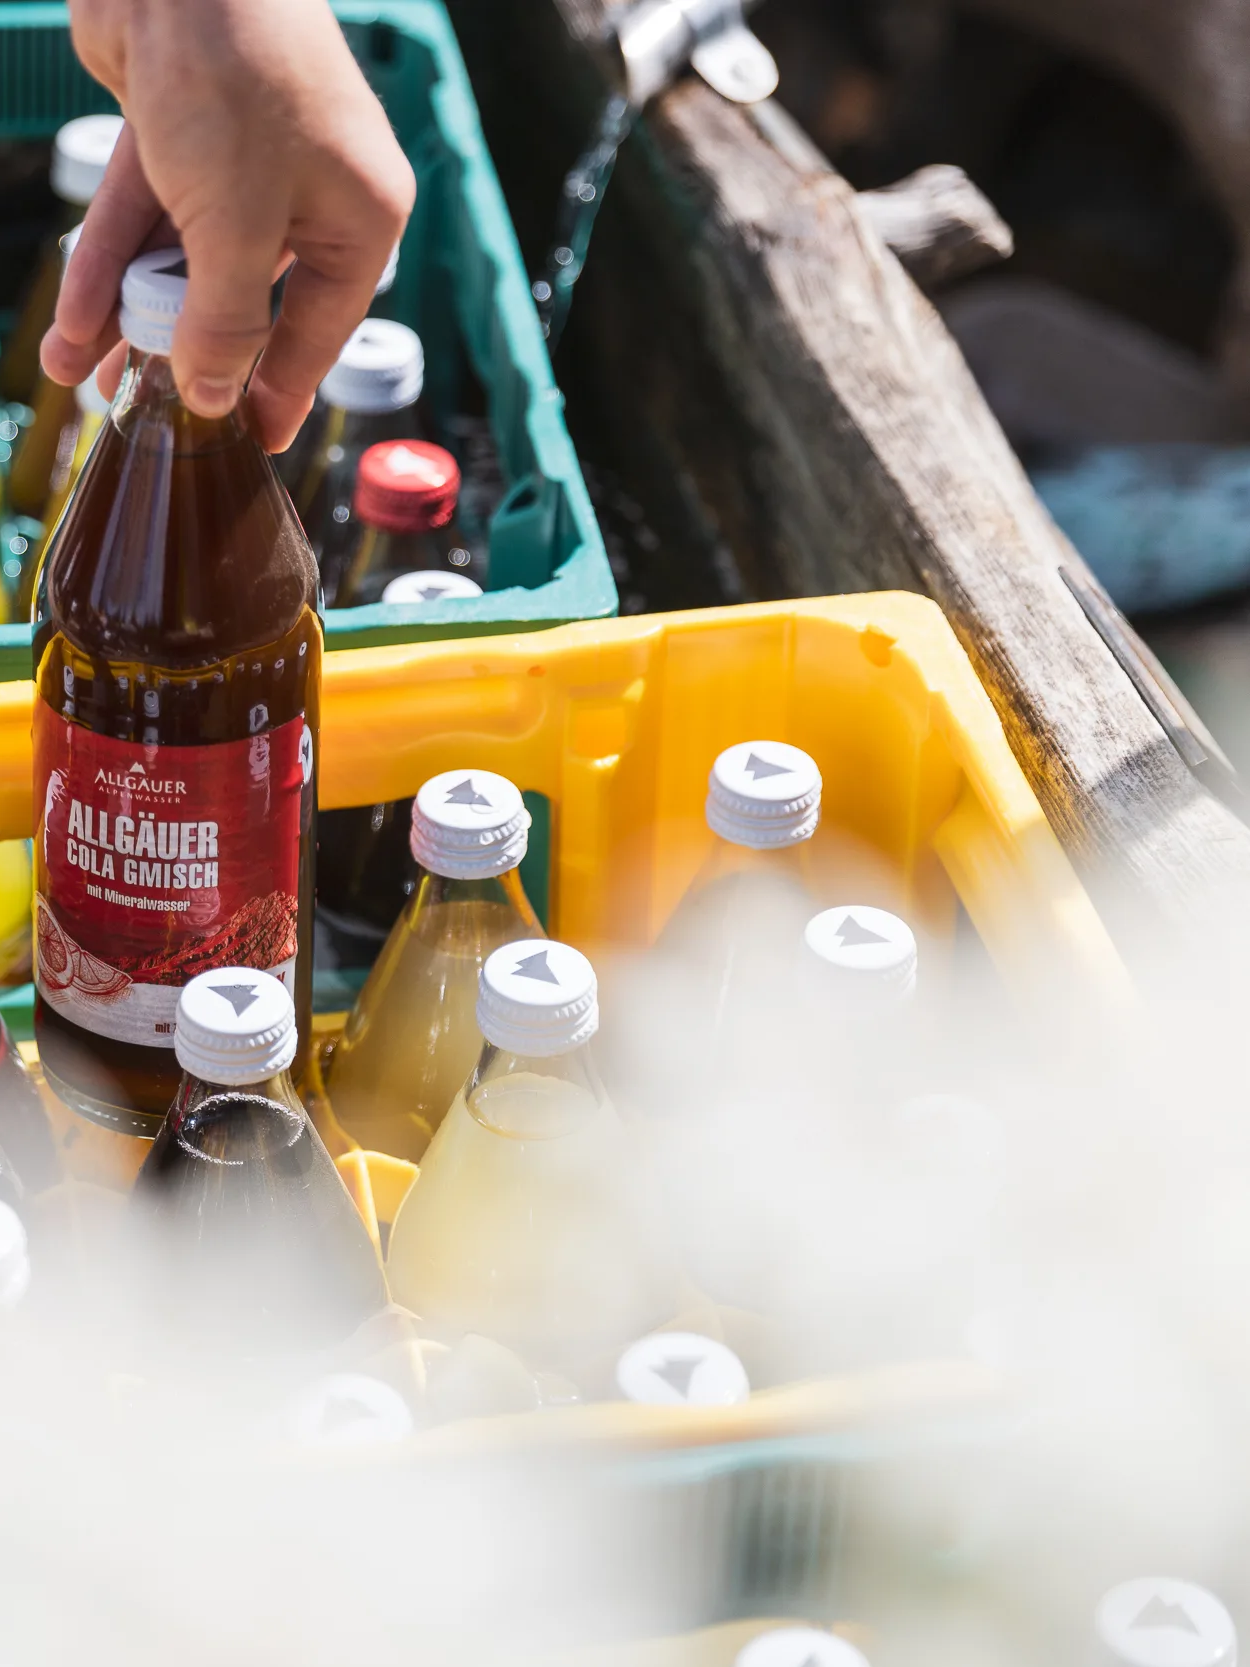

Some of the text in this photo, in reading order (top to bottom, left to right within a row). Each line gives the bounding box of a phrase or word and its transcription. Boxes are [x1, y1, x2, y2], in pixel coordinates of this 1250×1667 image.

[94, 768, 187, 795] ALLGÄUER
[98, 786, 181, 804] ALPENWASSER
[67, 799, 219, 860] ALLGÄUER
[67, 838, 219, 890] COLA GMISCH
[86, 883, 190, 911] mit Mineralwasser
[154, 1022, 171, 1034] mit
